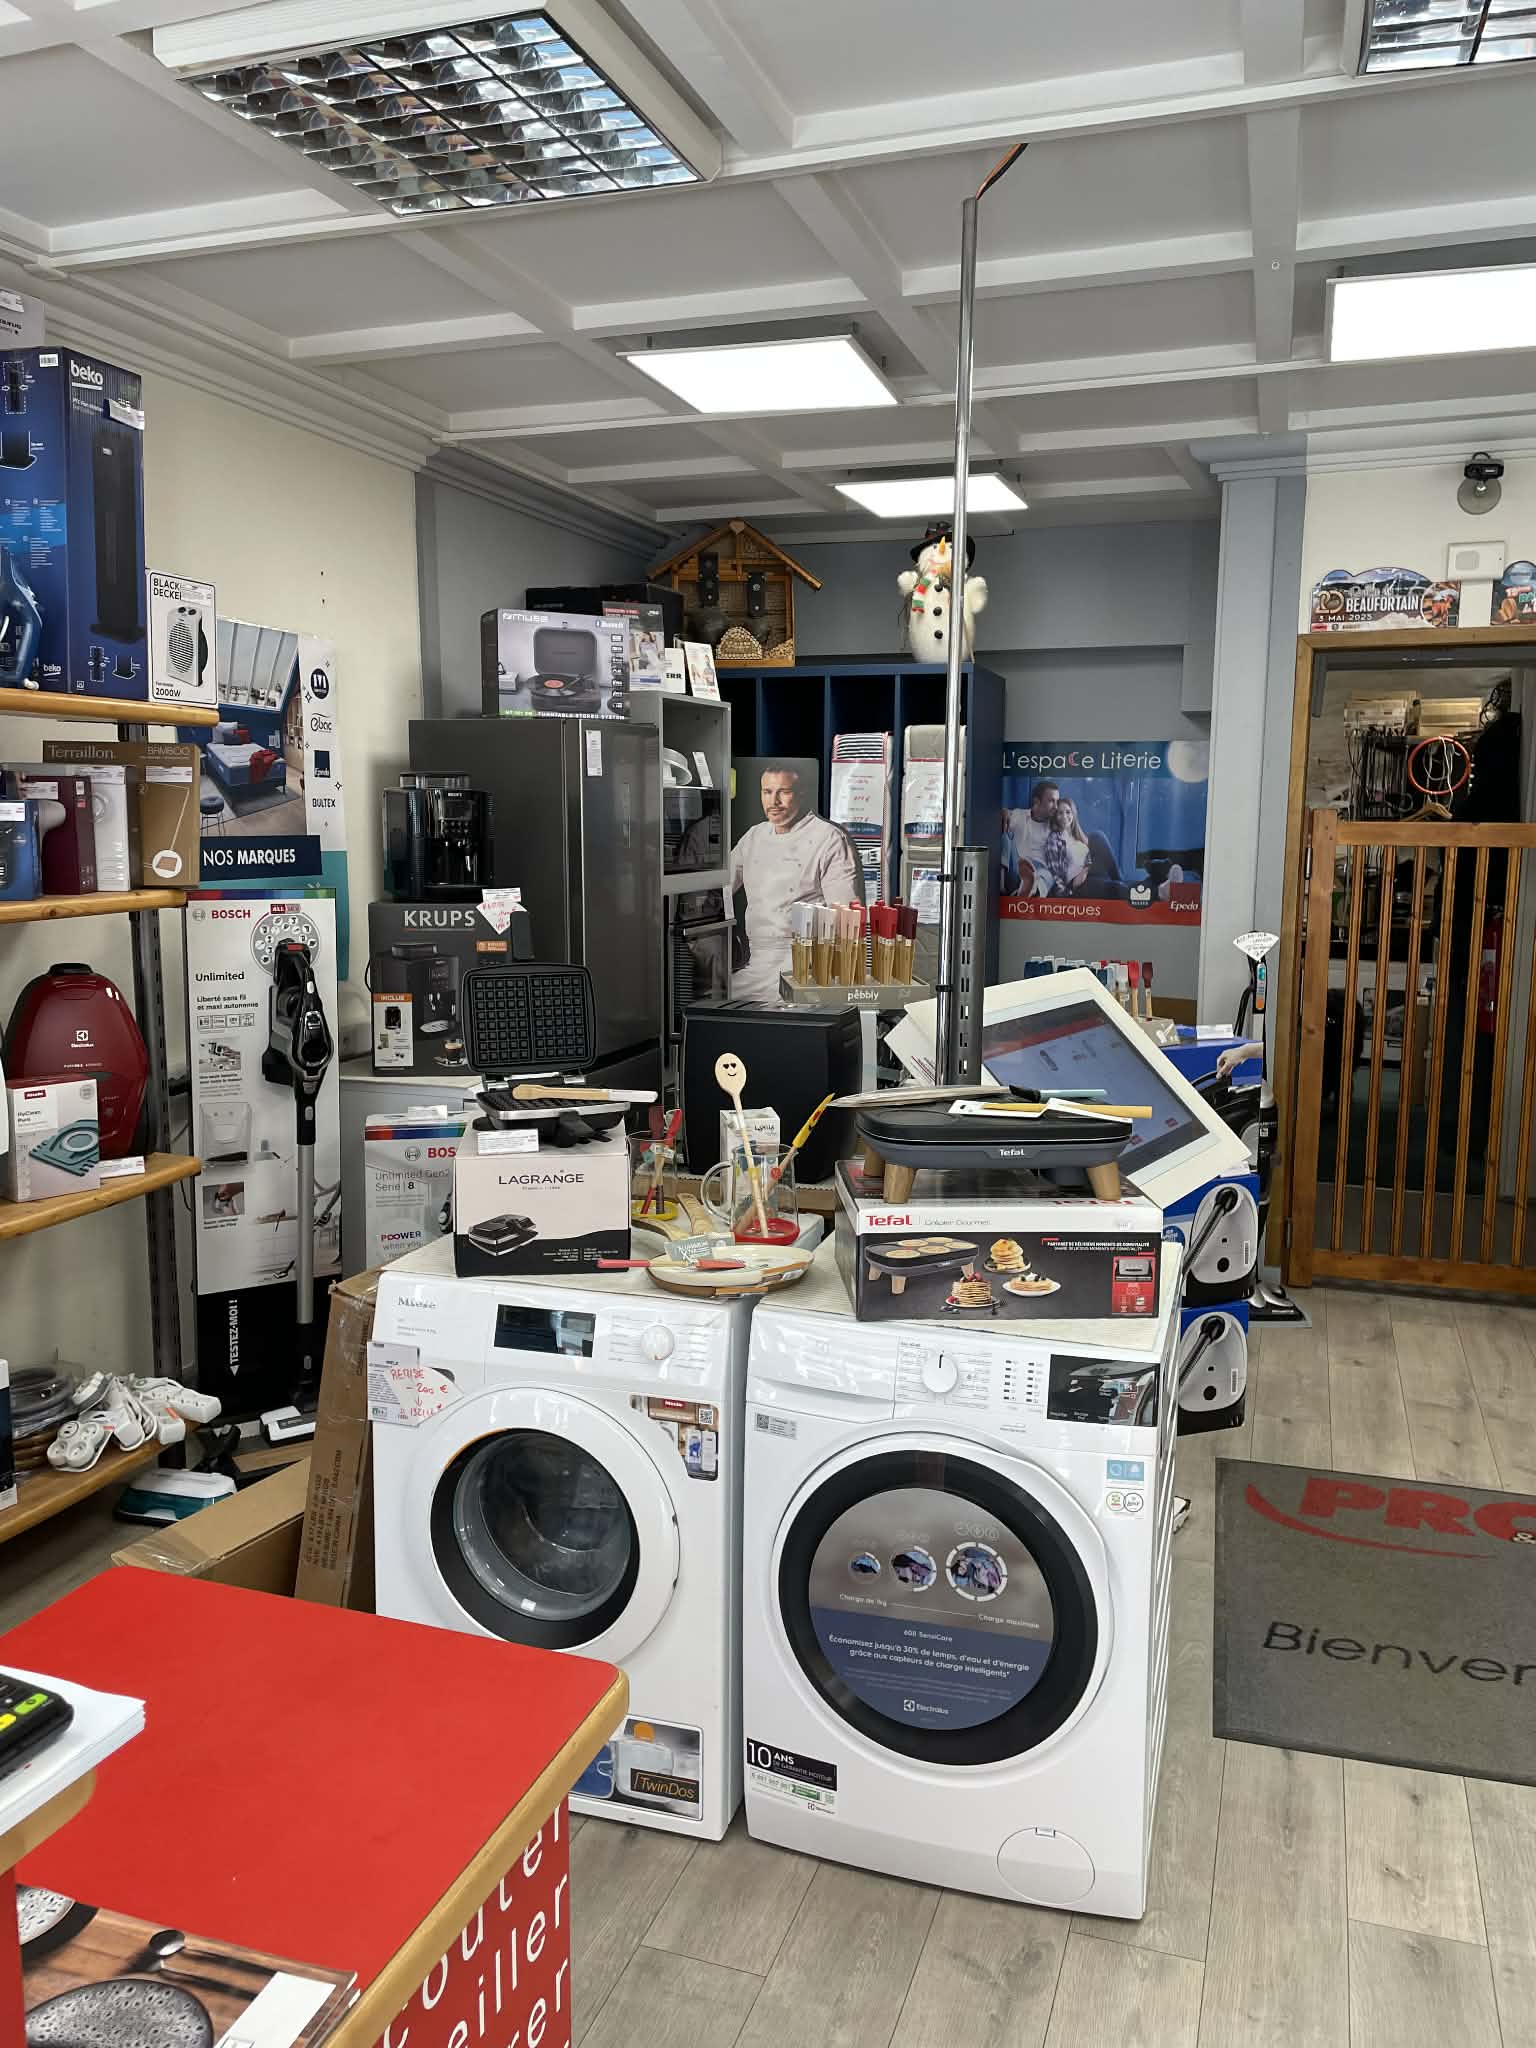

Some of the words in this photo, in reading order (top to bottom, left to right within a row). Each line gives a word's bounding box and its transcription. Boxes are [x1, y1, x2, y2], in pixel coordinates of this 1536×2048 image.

[70, 360, 104, 386] beko
[1345, 595, 1420, 613] BEAUFORTAIN
[1328, 614, 1345, 622] MAI
[155, 686, 182, 697] 2000W
[48, 744, 115, 760] Terraillon
[146, 745, 191, 756] BAMBOO
[1101, 751, 1162, 770] Literie
[312, 798, 336, 808] BULTEX
[203, 849, 234, 867] NOS
[236, 848, 296, 866] MARQUES
[211, 909, 251, 920] BOSCH
[1039, 903, 1101, 918] marques
[403, 910, 477, 928] KRUPS
[195, 971, 245, 982] Unlimited
[1000, 1148, 1025, 1157] Tefal
[407, 1181, 415, 1190] 8
[498, 1173, 585, 1185] LAGRANGE
[865, 1214, 913, 1227] Tefal
[397, 1296, 437, 1309] Miele
[229, 1307, 240, 1364] TESTEZ-MOI
[978, 1613, 1003, 1625] Charge
[828, 1634, 873, 1648] Économisez
[920, 1648, 931, 1656] de
[874, 1652, 888, 1661] aux
[889, 1654, 923, 1667] capteurs
[924, 1659, 934, 1667] de
[936, 1661, 963, 1673] charge
[916, 1703, 950, 1715] Electrolux
[748, 1742, 772, 1769] 10
[773, 1752, 796, 1766] ANS
[637, 1774, 696, 1800] TwinDos
